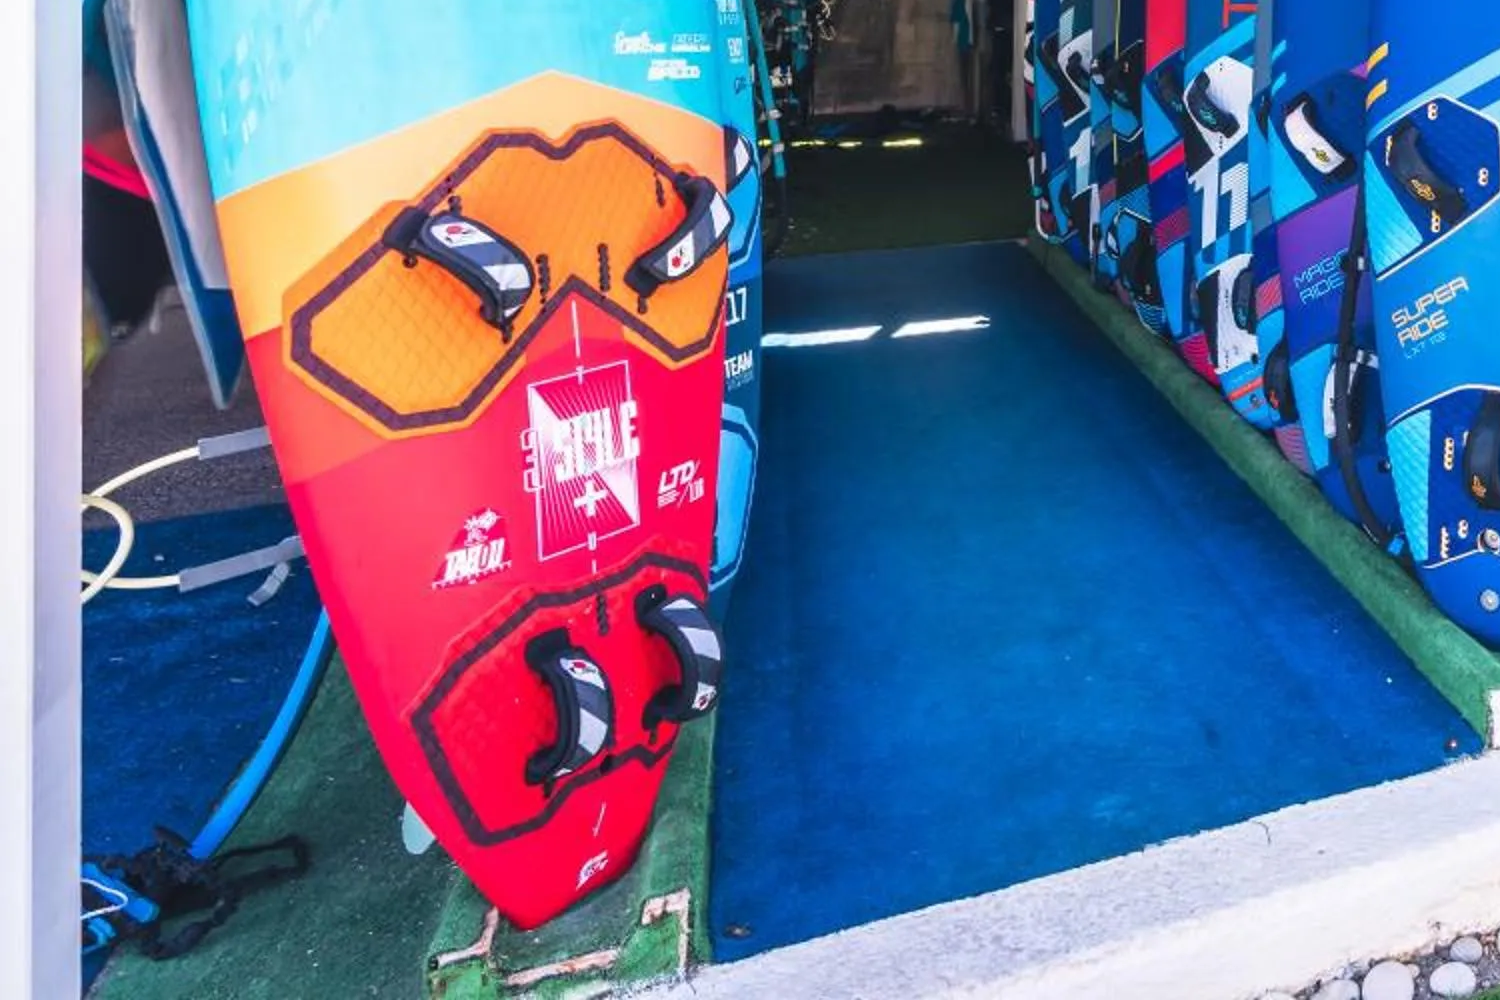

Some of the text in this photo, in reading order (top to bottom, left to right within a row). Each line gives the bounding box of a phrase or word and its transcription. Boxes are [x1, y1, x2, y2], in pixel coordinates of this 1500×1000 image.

[1391, 276, 1469, 329] SUPER
[1397, 309, 1449, 348] RIDE
[659, 460, 697, 495] LTD
